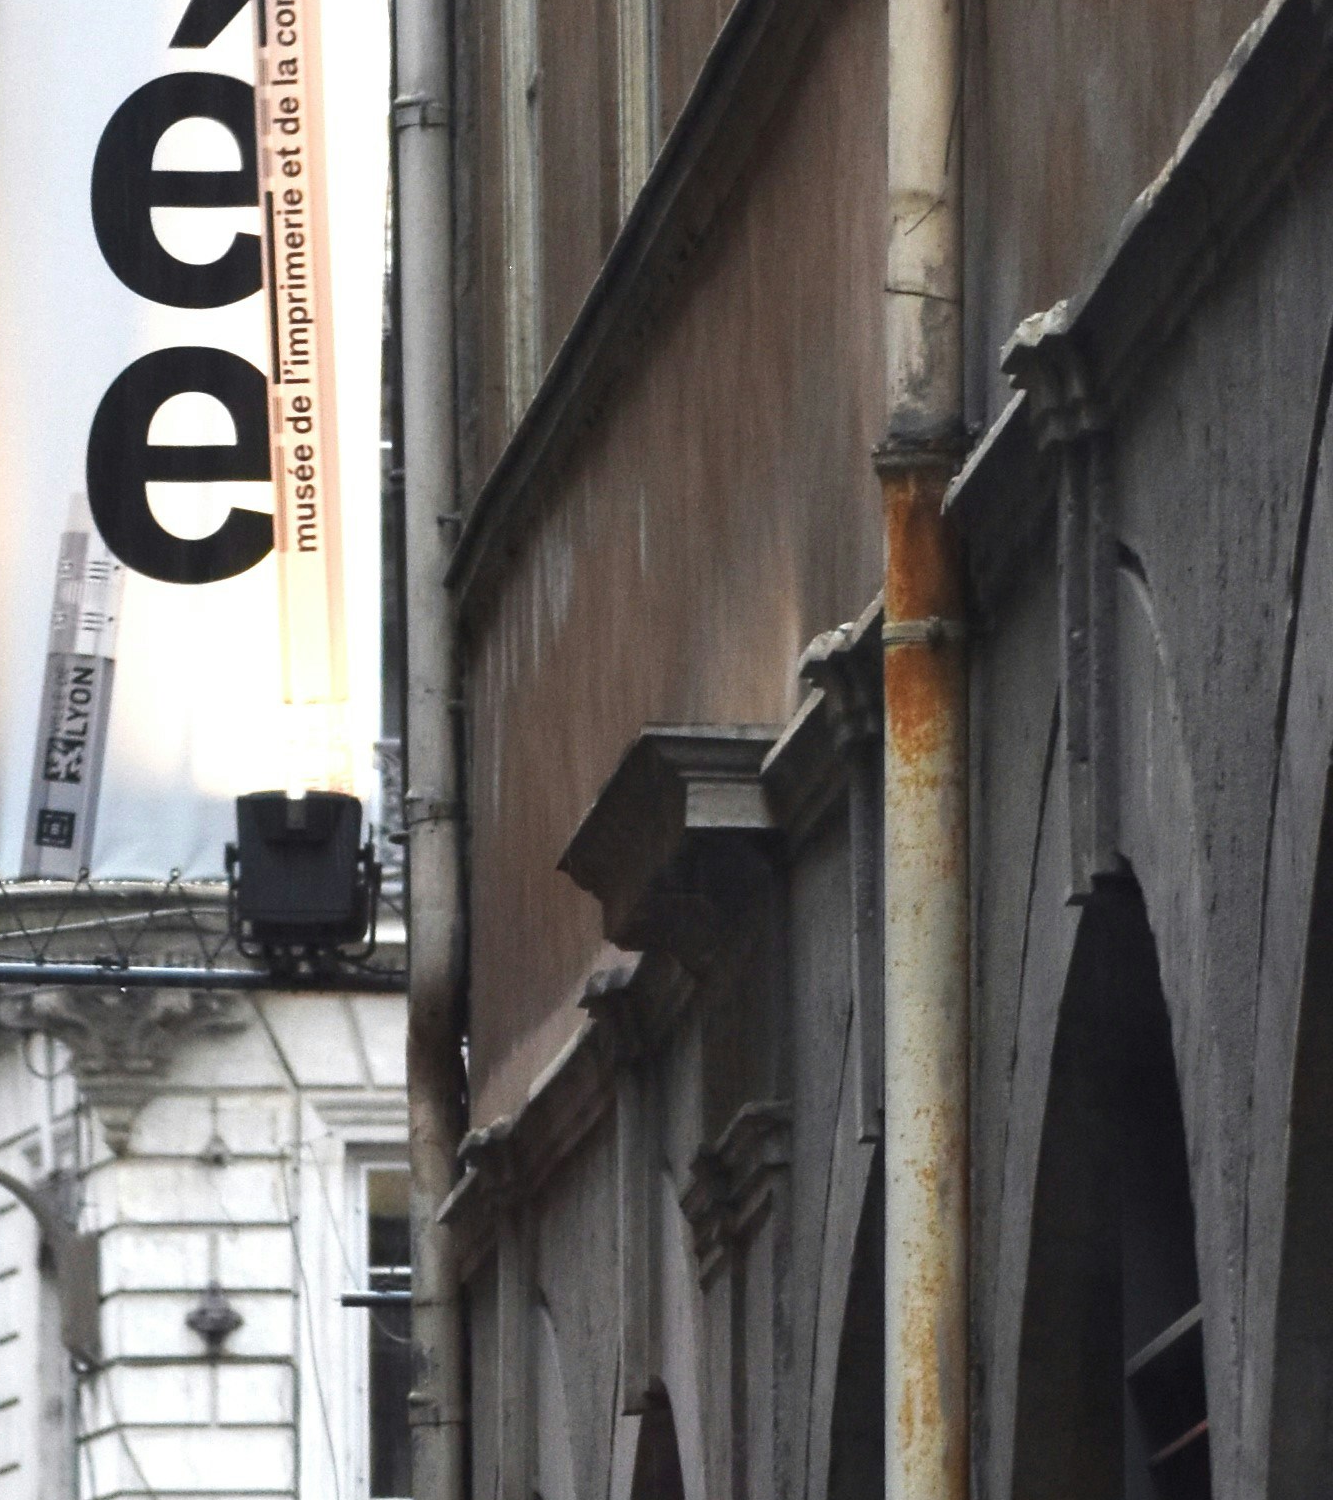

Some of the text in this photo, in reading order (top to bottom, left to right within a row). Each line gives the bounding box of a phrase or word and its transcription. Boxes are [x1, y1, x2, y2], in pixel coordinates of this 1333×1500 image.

[270, 56, 299, 87] la
[272, 96, 301, 136] de
[276, 146, 303, 179] et
[285, 395, 313, 435] de
[294, 443, 318, 553] musée
[66, 665, 96, 740] LYON
